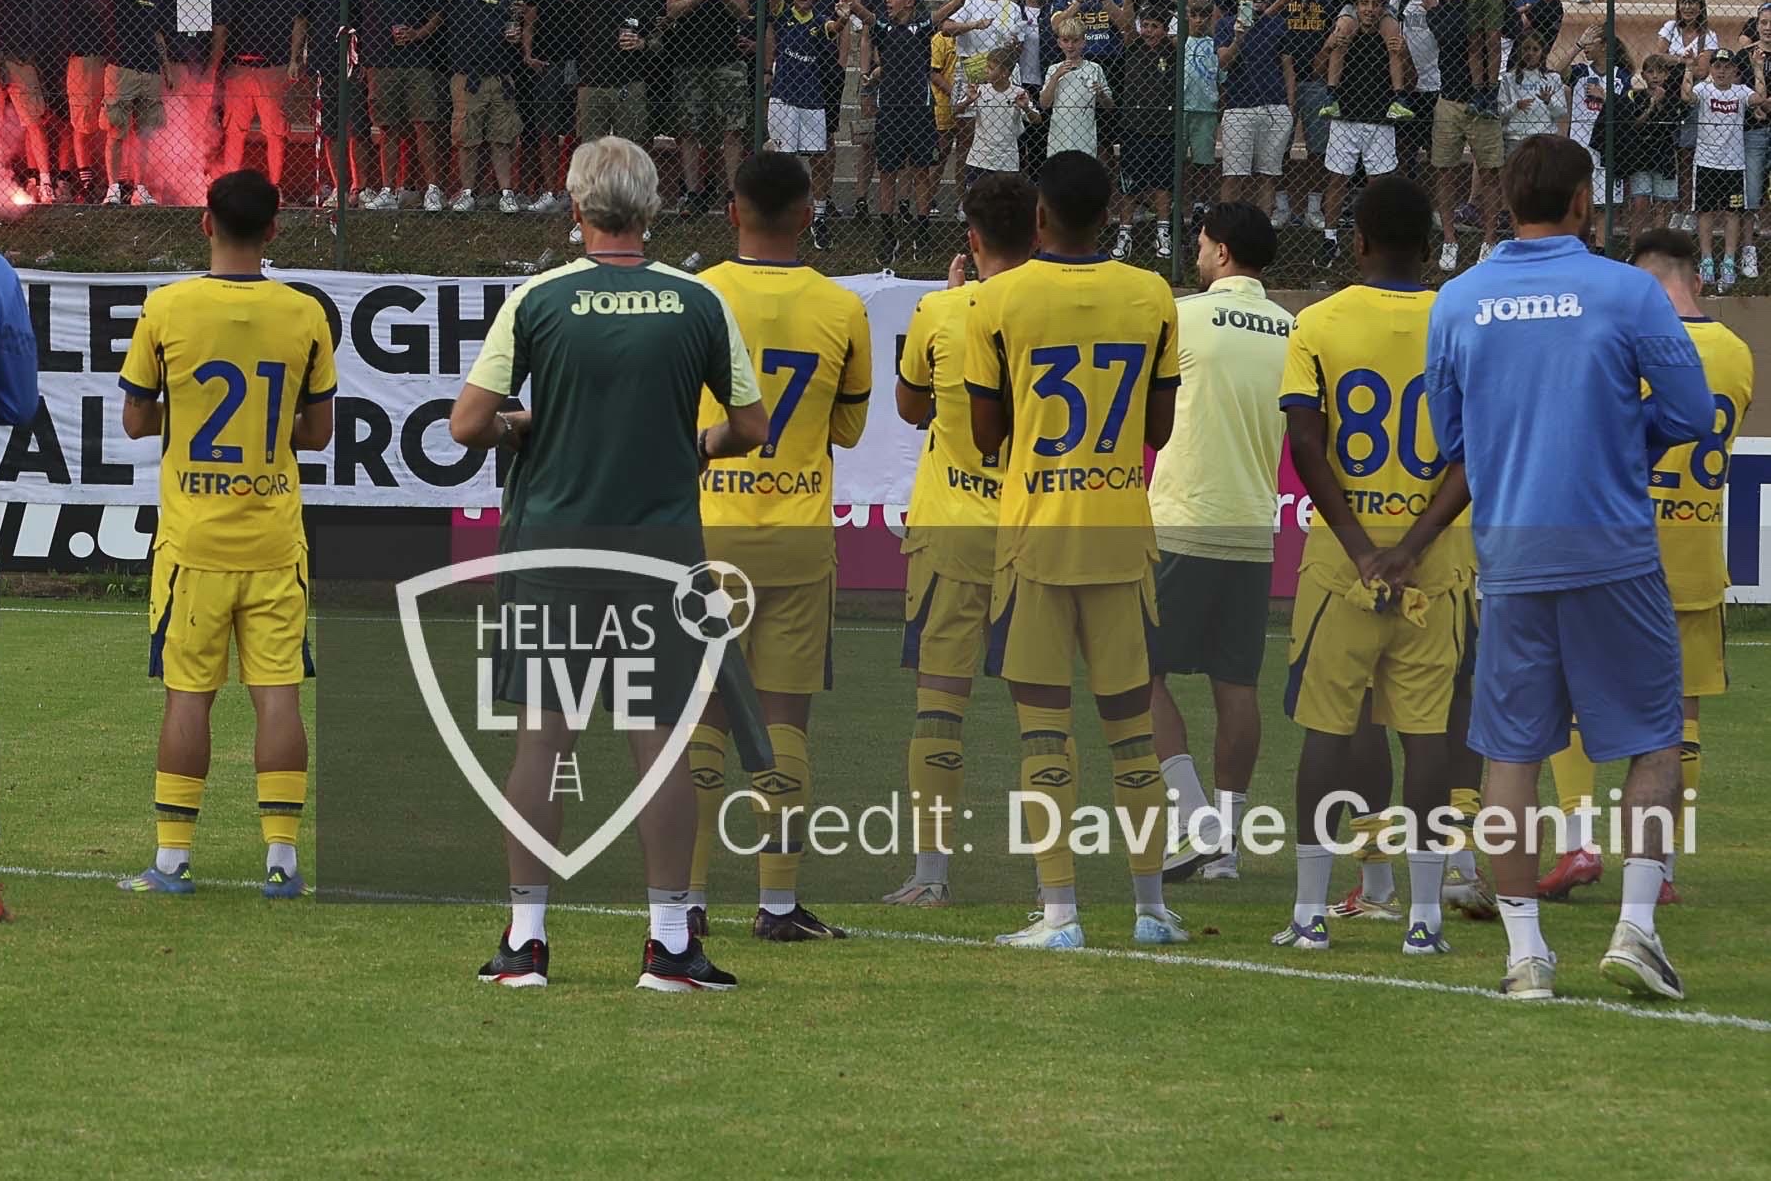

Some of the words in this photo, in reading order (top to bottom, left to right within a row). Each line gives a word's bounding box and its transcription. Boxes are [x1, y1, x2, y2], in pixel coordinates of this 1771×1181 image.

[571, 290, 685, 316] Joma
[1475, 293, 1583, 326] Joma
[1212, 305, 1290, 339] Joma
[189, 360, 287, 465] 21
[758, 347, 820, 459] 7
[1030, 342, 1147, 458] 37
[1336, 367, 1450, 482] 80
[177, 471, 292, 497] VETROCAR
[699, 470, 823, 495] VETROCAR
[948, 466, 1004, 500] VETR
